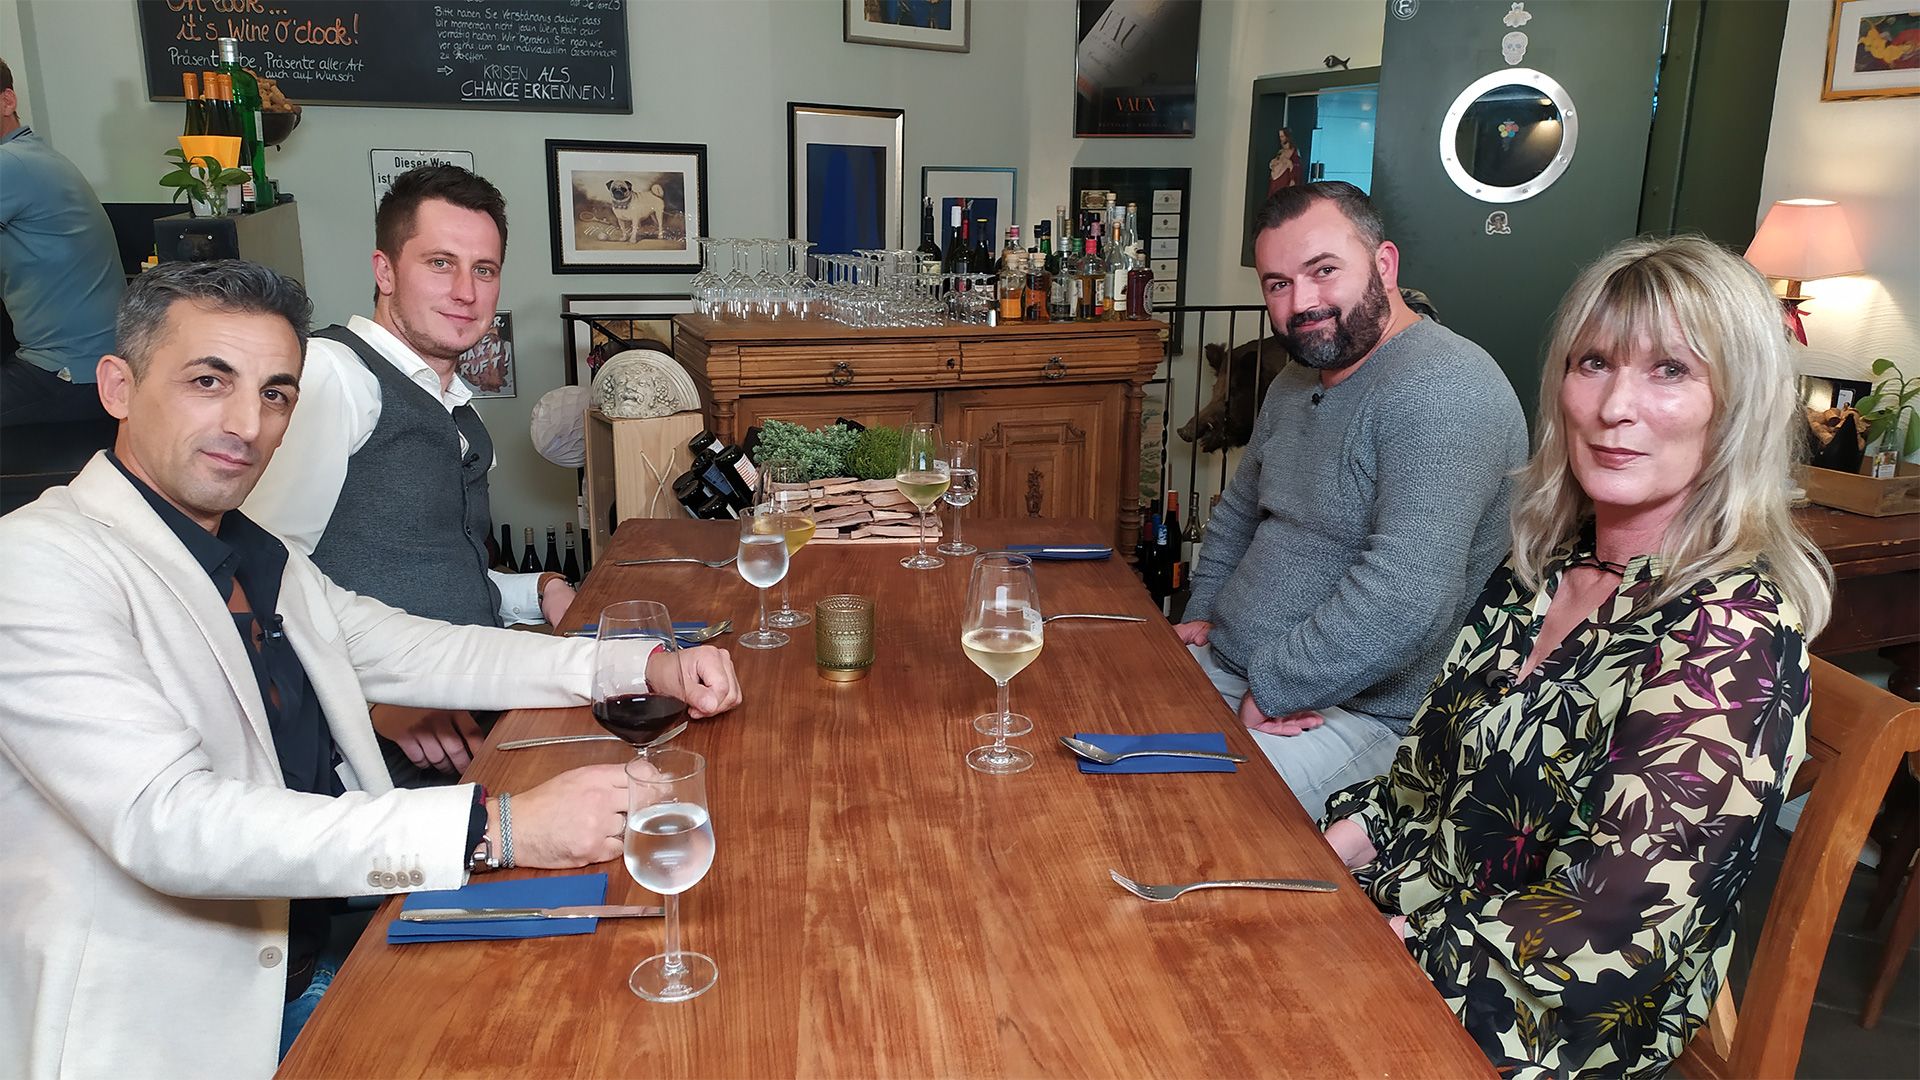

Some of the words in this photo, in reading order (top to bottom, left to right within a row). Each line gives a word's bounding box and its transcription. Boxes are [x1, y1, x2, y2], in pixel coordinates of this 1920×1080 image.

[167, 46, 262, 71] Präsentbe,
[264, 51, 315, 70] Präsente
[319, 56, 345, 71] aller
[345, 57, 364, 71] Art
[265, 69, 289, 79] auch
[292, 70, 313, 83] auf
[483, 64, 529, 81] KRISEN
[538, 66, 571, 84] ALS
[460, 80, 519, 98] CHANCE
[394, 156, 428, 168] Dieser
[377, 172, 392, 184] ist
